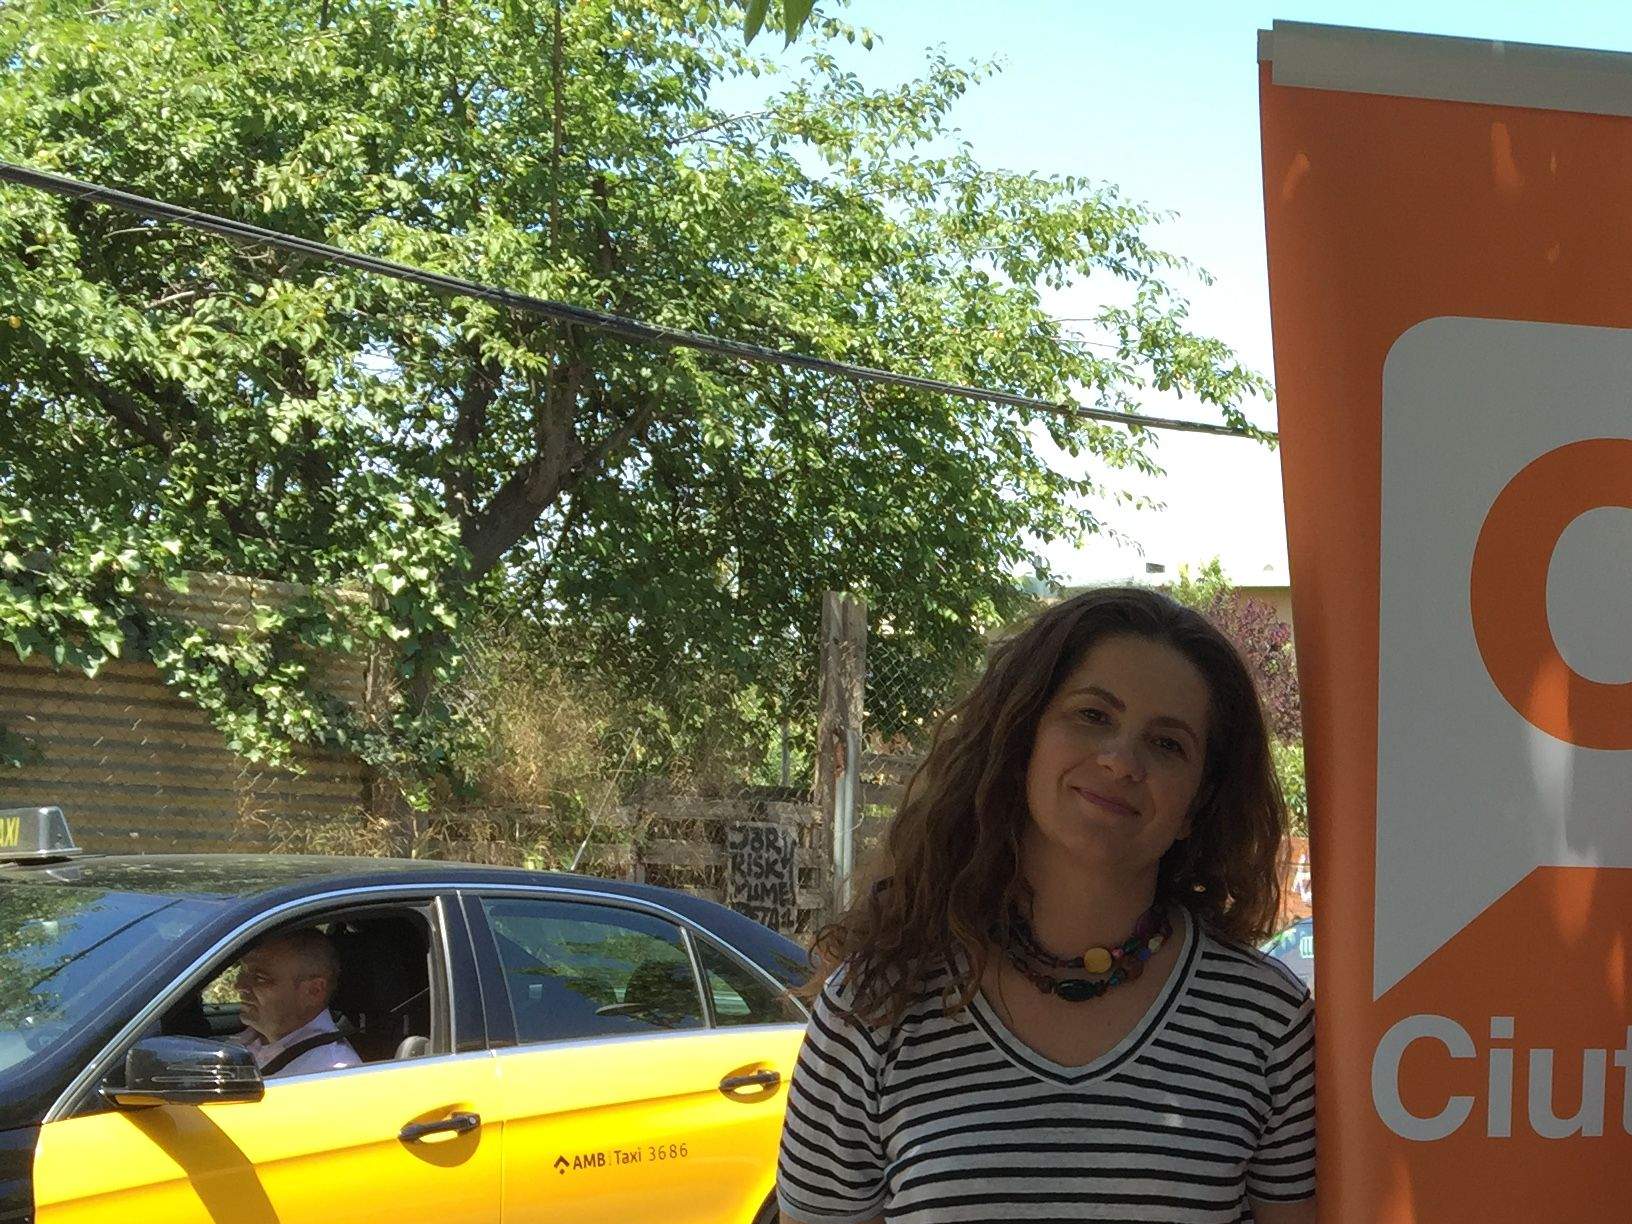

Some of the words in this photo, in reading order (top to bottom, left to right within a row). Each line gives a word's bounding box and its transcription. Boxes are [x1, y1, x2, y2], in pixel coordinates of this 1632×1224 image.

[573, 1152, 606, 1170] AMB
[614, 1147, 641, 1165] Taxi
[649, 1143, 688, 1162] 3686
